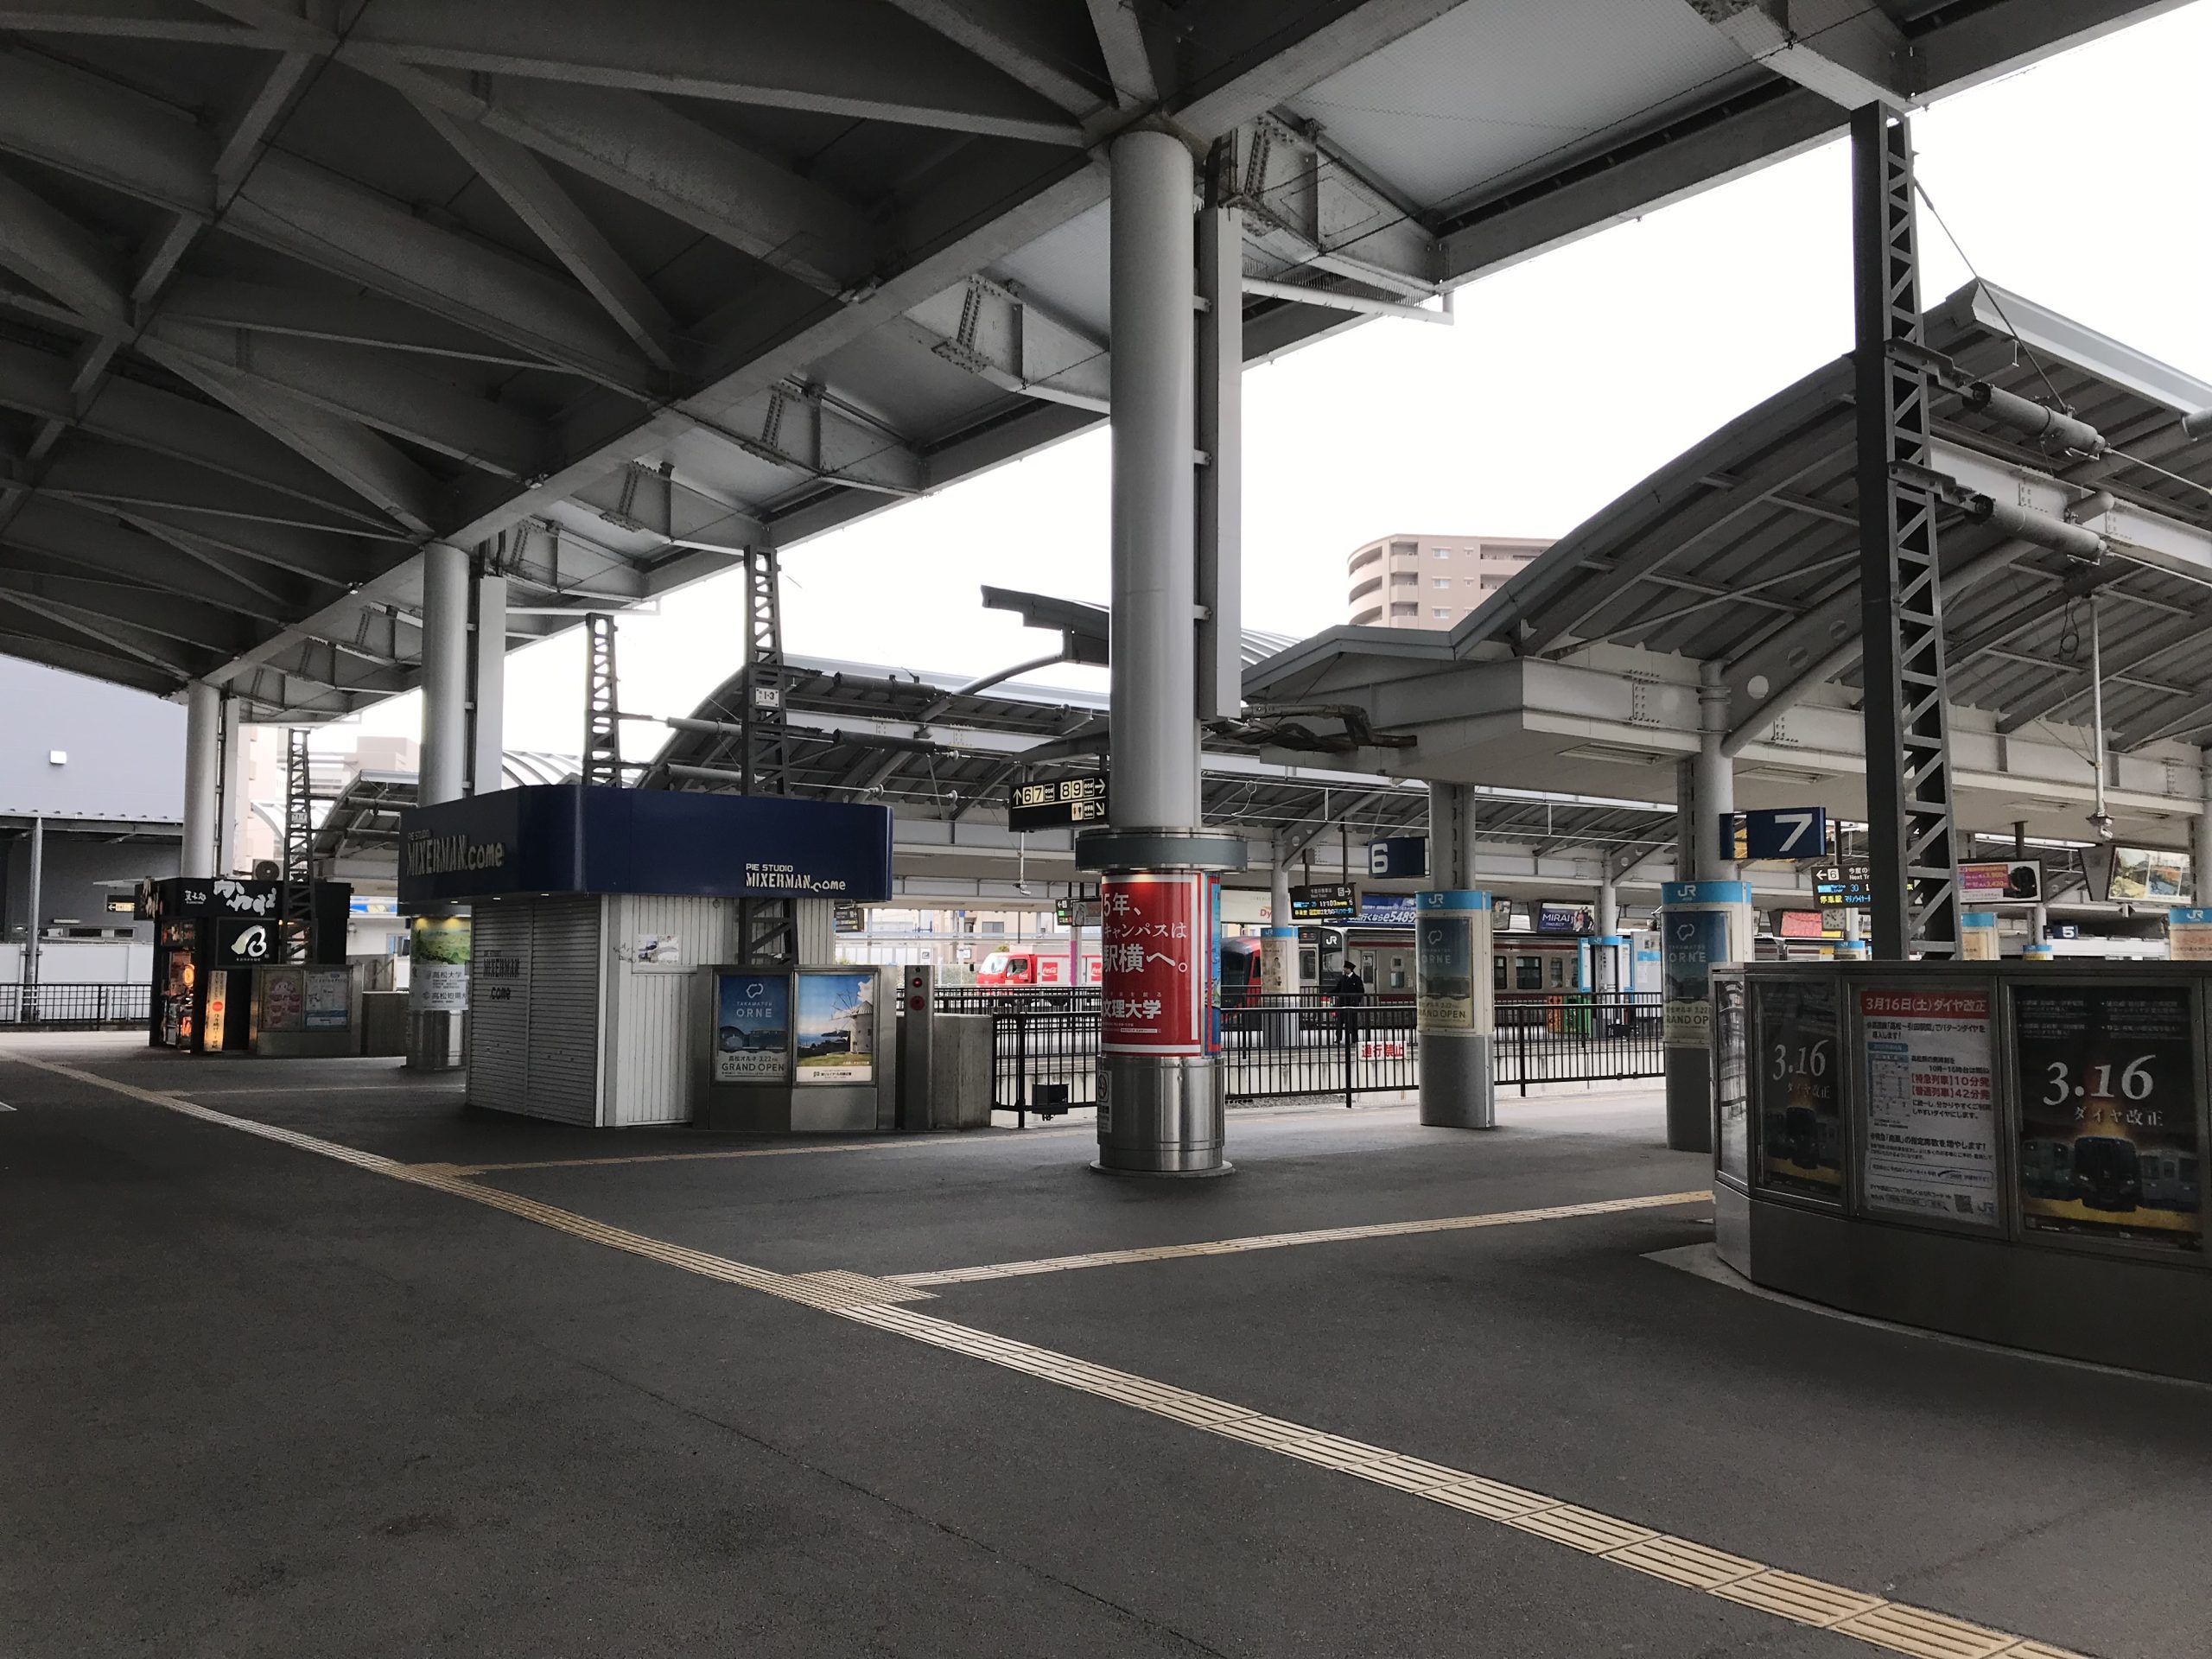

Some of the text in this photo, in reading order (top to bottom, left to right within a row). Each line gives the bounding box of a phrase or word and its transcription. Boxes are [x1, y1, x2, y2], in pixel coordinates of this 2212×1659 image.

[1024, 787, 1042, 803] 6 7
[1062, 782, 1081, 798] 8 9
[1775, 813, 1813, 852] 7
[1371, 842, 1389, 874] 6
[746, 863, 793, 873] PIE STUDIO
[1830, 870, 1837, 879] 6
[1677, 884, 1696, 897] JR
[1428, 893, 1444, 905] JR
[1541, 913, 1570, 923] MIRAI
[2186, 910, 2204, 919] JR
[1104, 922, 1186, 939] キャンパスは
[2062, 925, 2075, 938] 5
[1325, 935, 1338, 945] JR
[1103, 943, 1187, 973] 駅横へ。
[1421, 955, 1452, 964] ORNE
[1669, 952, 1707, 963] ORNE
[736, 1008, 772, 1018] ORNE
[1103, 998, 1161, 1020] 文理大学
[1440, 1009, 1465, 1018] OPEN
[1361, 1043, 1403, 1058] 通行禁止
[1772, 1039, 1829, 1081] 3.16
[721, 1063, 756, 1071] GRAND
[2043, 1054, 2157, 1106] 3.16
[2074, 1106, 2164, 1127] ダイヤ改正
